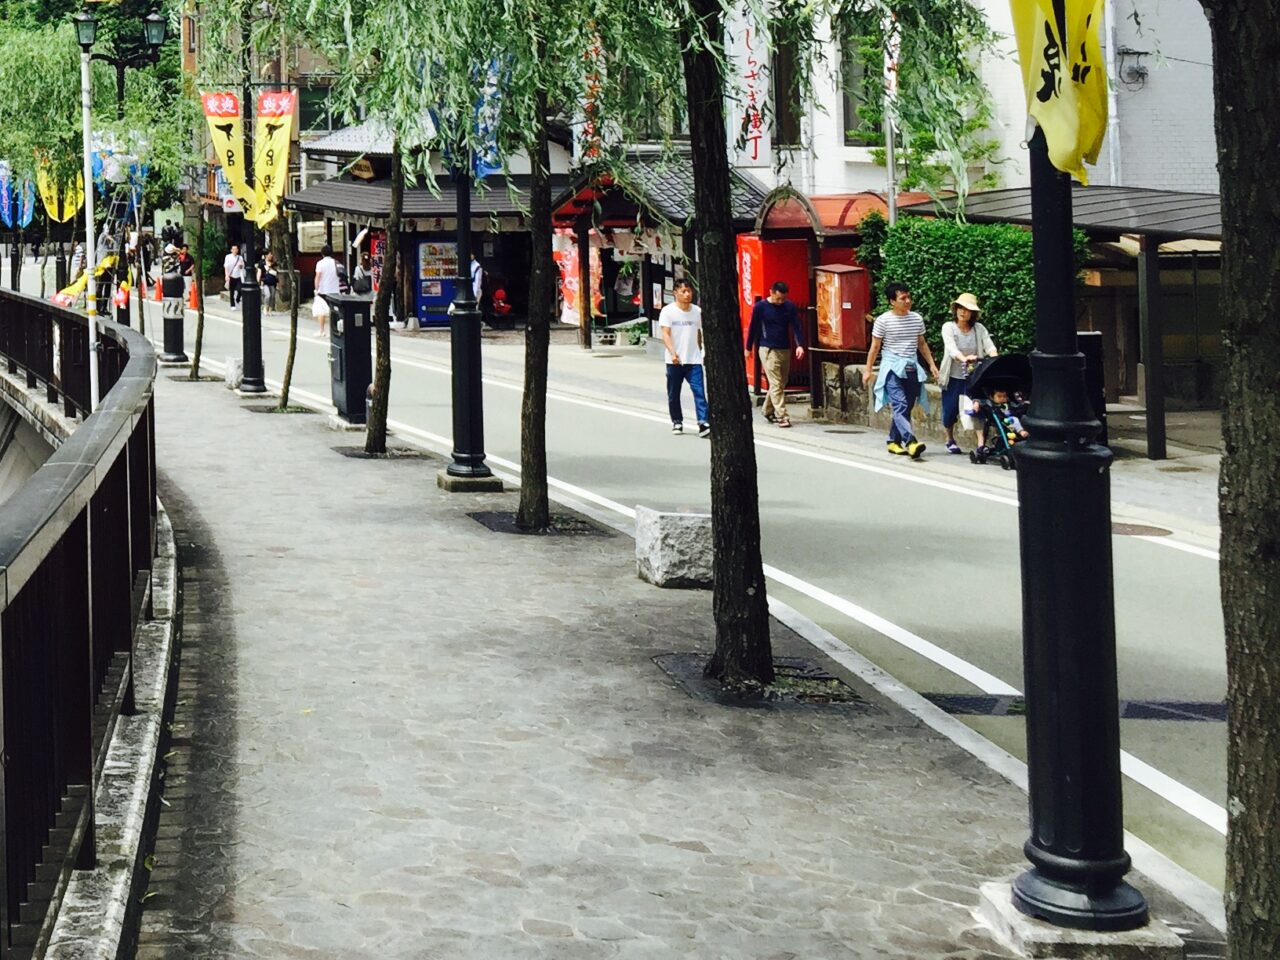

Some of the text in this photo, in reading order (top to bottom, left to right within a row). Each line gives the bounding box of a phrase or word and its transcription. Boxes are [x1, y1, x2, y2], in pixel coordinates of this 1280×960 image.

[741, 28, 763, 160] しらさぎ横丁
